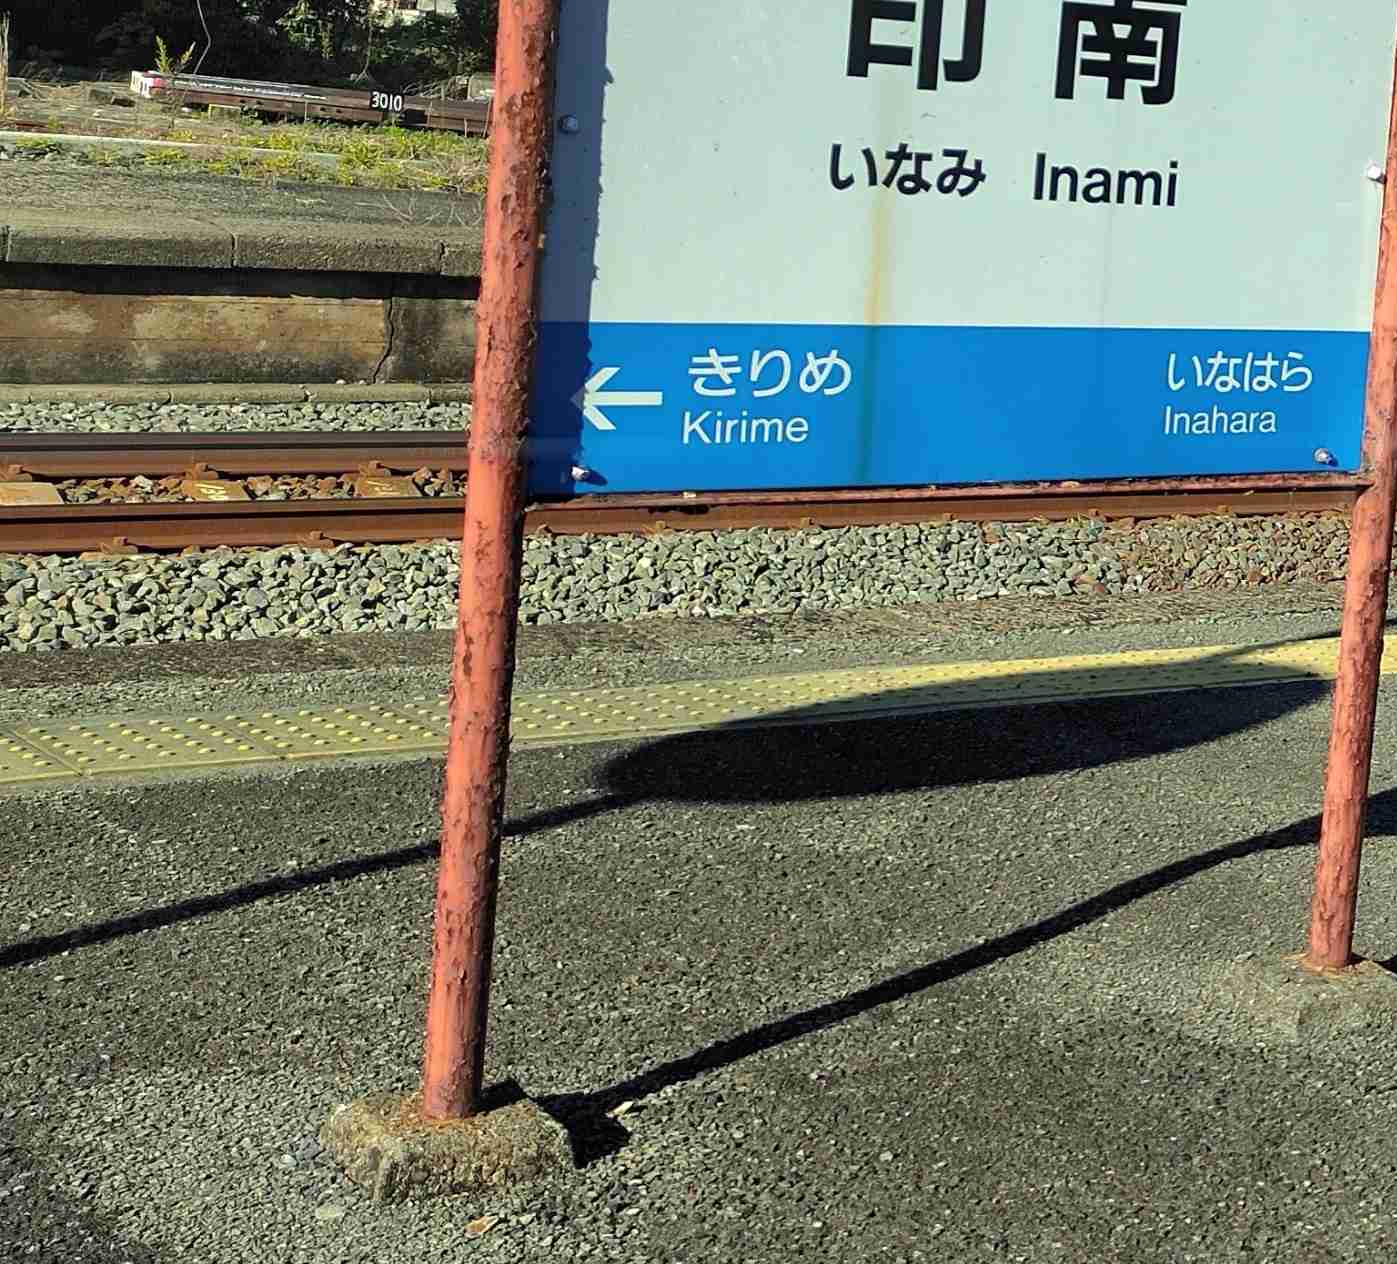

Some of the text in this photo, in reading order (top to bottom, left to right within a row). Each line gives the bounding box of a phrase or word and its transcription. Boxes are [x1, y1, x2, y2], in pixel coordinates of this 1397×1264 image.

[371, 91, 403, 112] 3010
[829, 142, 987, 197] いなみ
[1033, 152, 1179, 207] Inami
[688, 348, 852, 397] きりめ
[1167, 350, 1313, 392] いなはら
[682, 411, 809, 444] Kirime
[1164, 404, 1277, 435] Inahara
